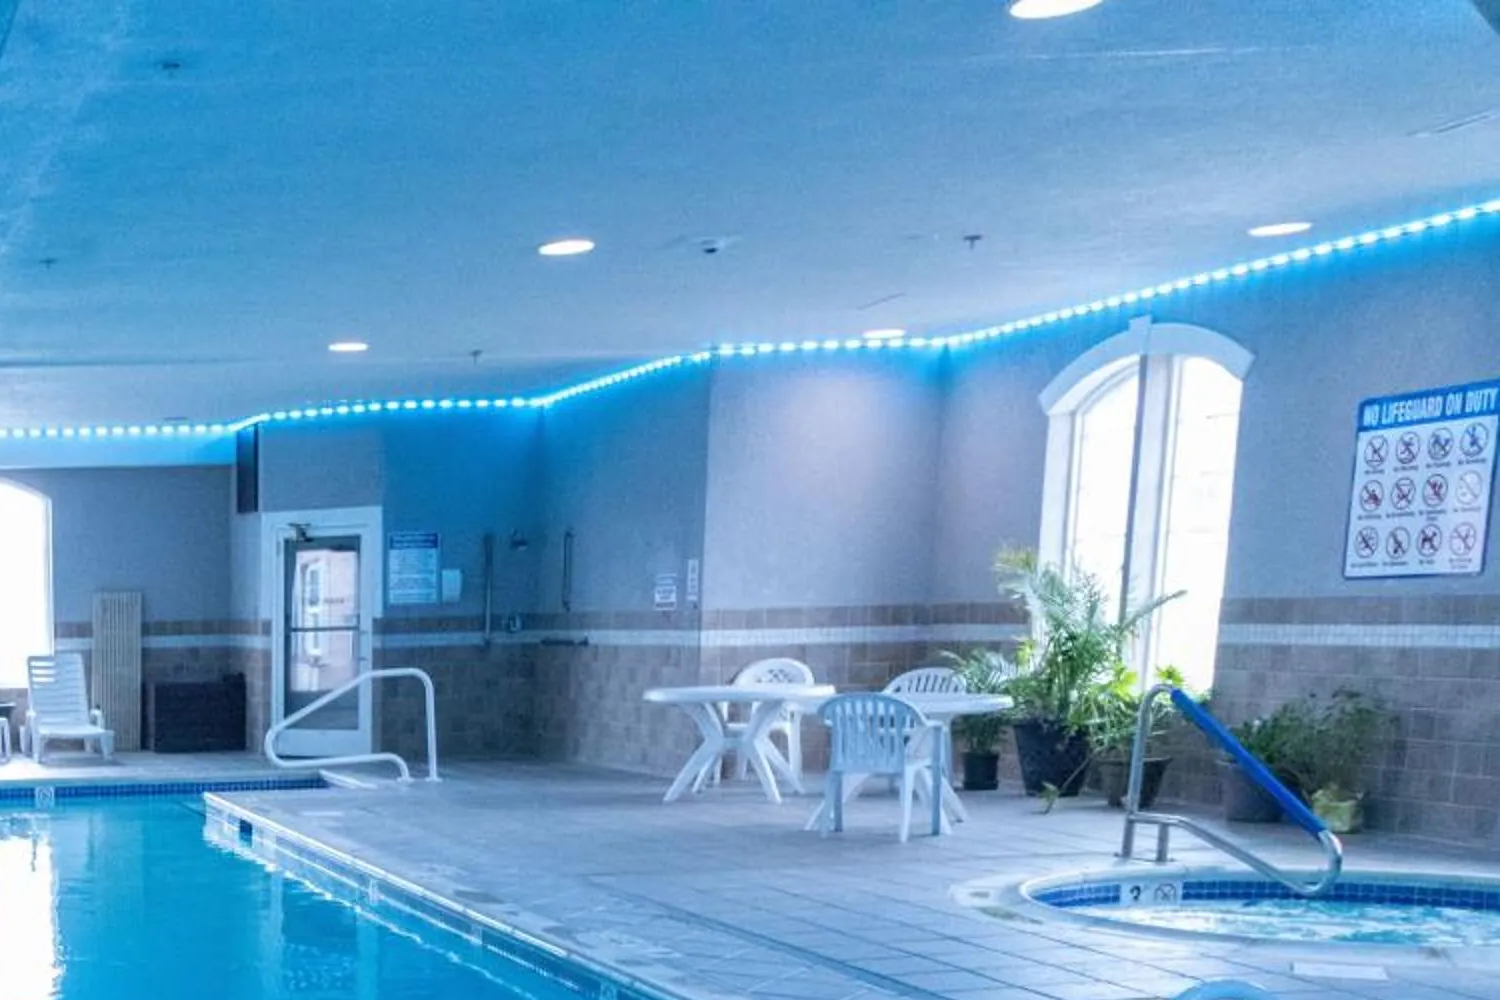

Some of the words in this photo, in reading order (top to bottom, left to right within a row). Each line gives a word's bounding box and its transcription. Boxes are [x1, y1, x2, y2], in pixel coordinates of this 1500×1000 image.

[1363, 404, 1379, 427] NO
[1382, 397, 1443, 425] LIFEGUARD
[1446, 392, 1462, 416] ON
[1465, 387, 1498, 413] DUTY
